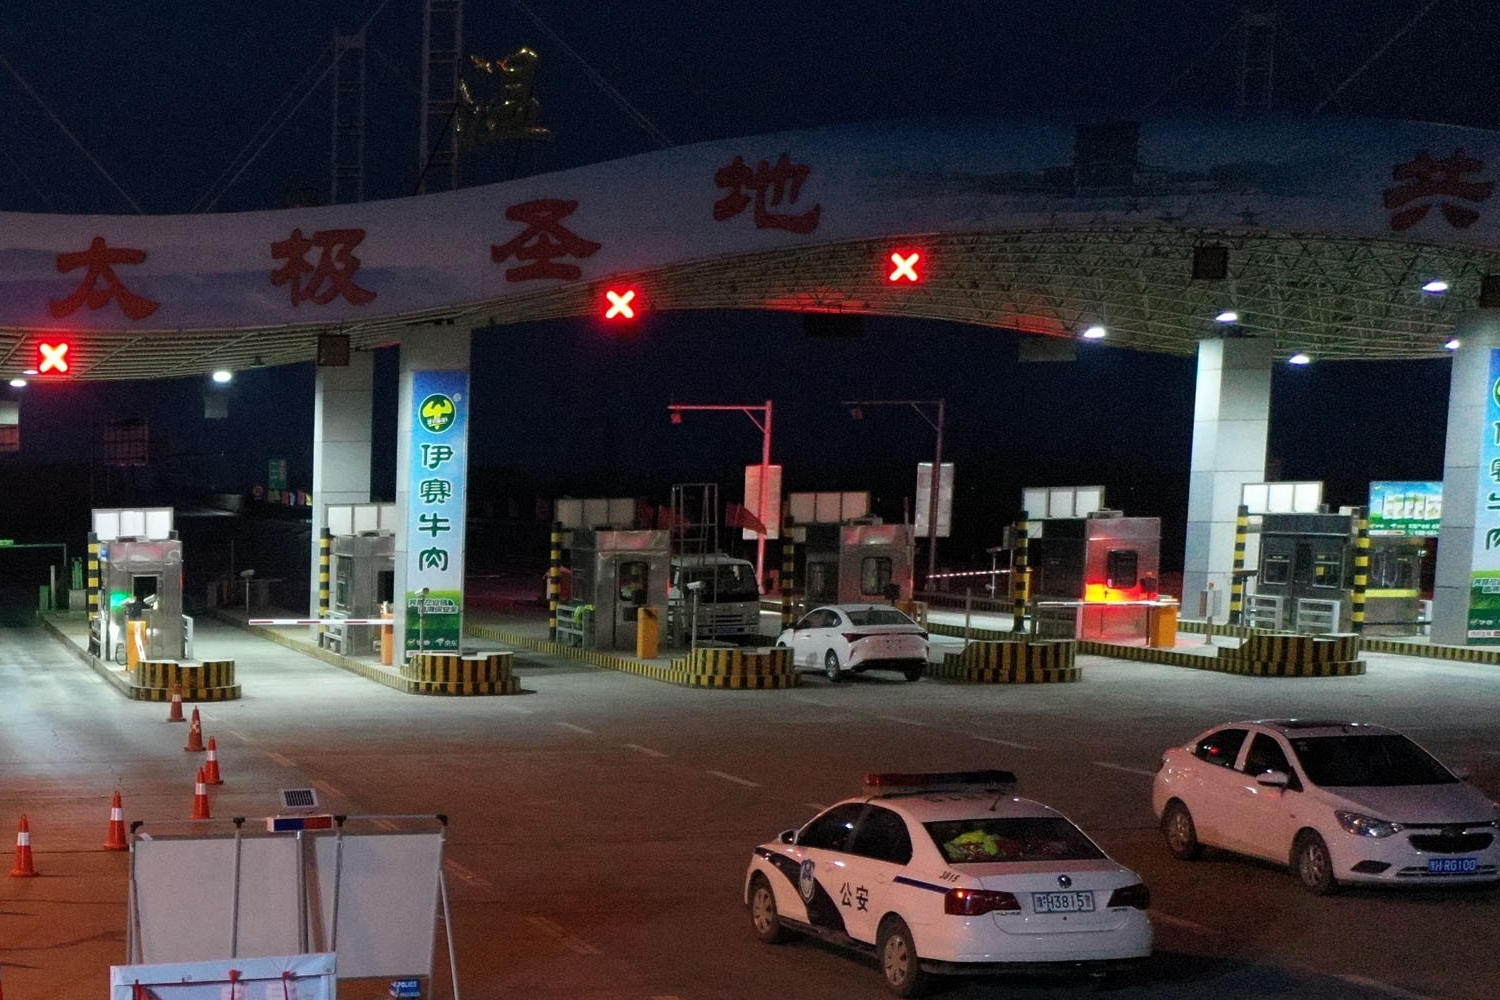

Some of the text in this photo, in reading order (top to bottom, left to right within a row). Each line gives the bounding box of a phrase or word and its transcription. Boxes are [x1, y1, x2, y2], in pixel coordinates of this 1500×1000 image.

[418, 443, 454, 572] 伊赛牛肉
[839, 881, 870, 913] 公安
